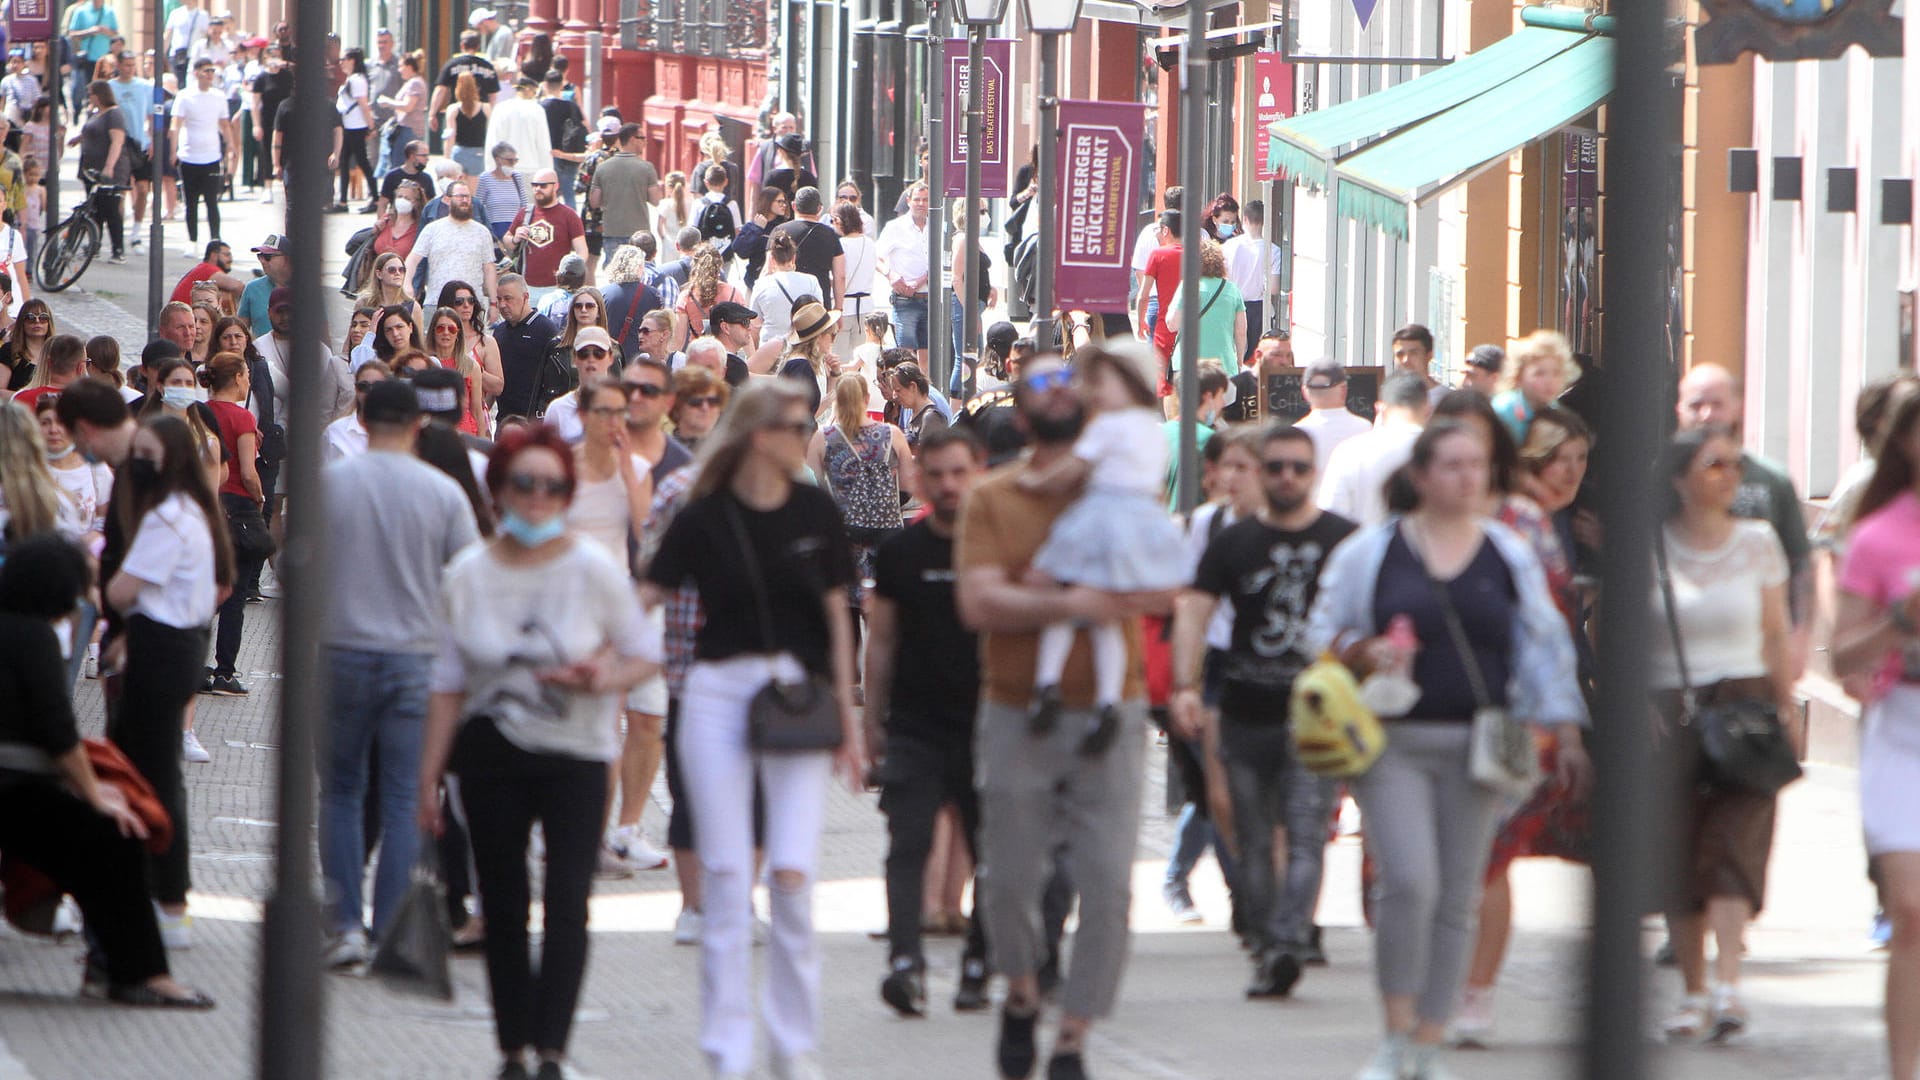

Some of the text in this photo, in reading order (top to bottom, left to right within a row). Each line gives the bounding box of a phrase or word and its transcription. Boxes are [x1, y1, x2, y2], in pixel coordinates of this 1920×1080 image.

[986, 79, 995, 154] DAS THEATERFESTIVAL
[1070, 135, 1092, 255] HEIDELBERGER
[1085, 136, 1110, 256] STÜCKEMARKT
[1105, 156, 1122, 256] DAS THEATERFESTIVAL
